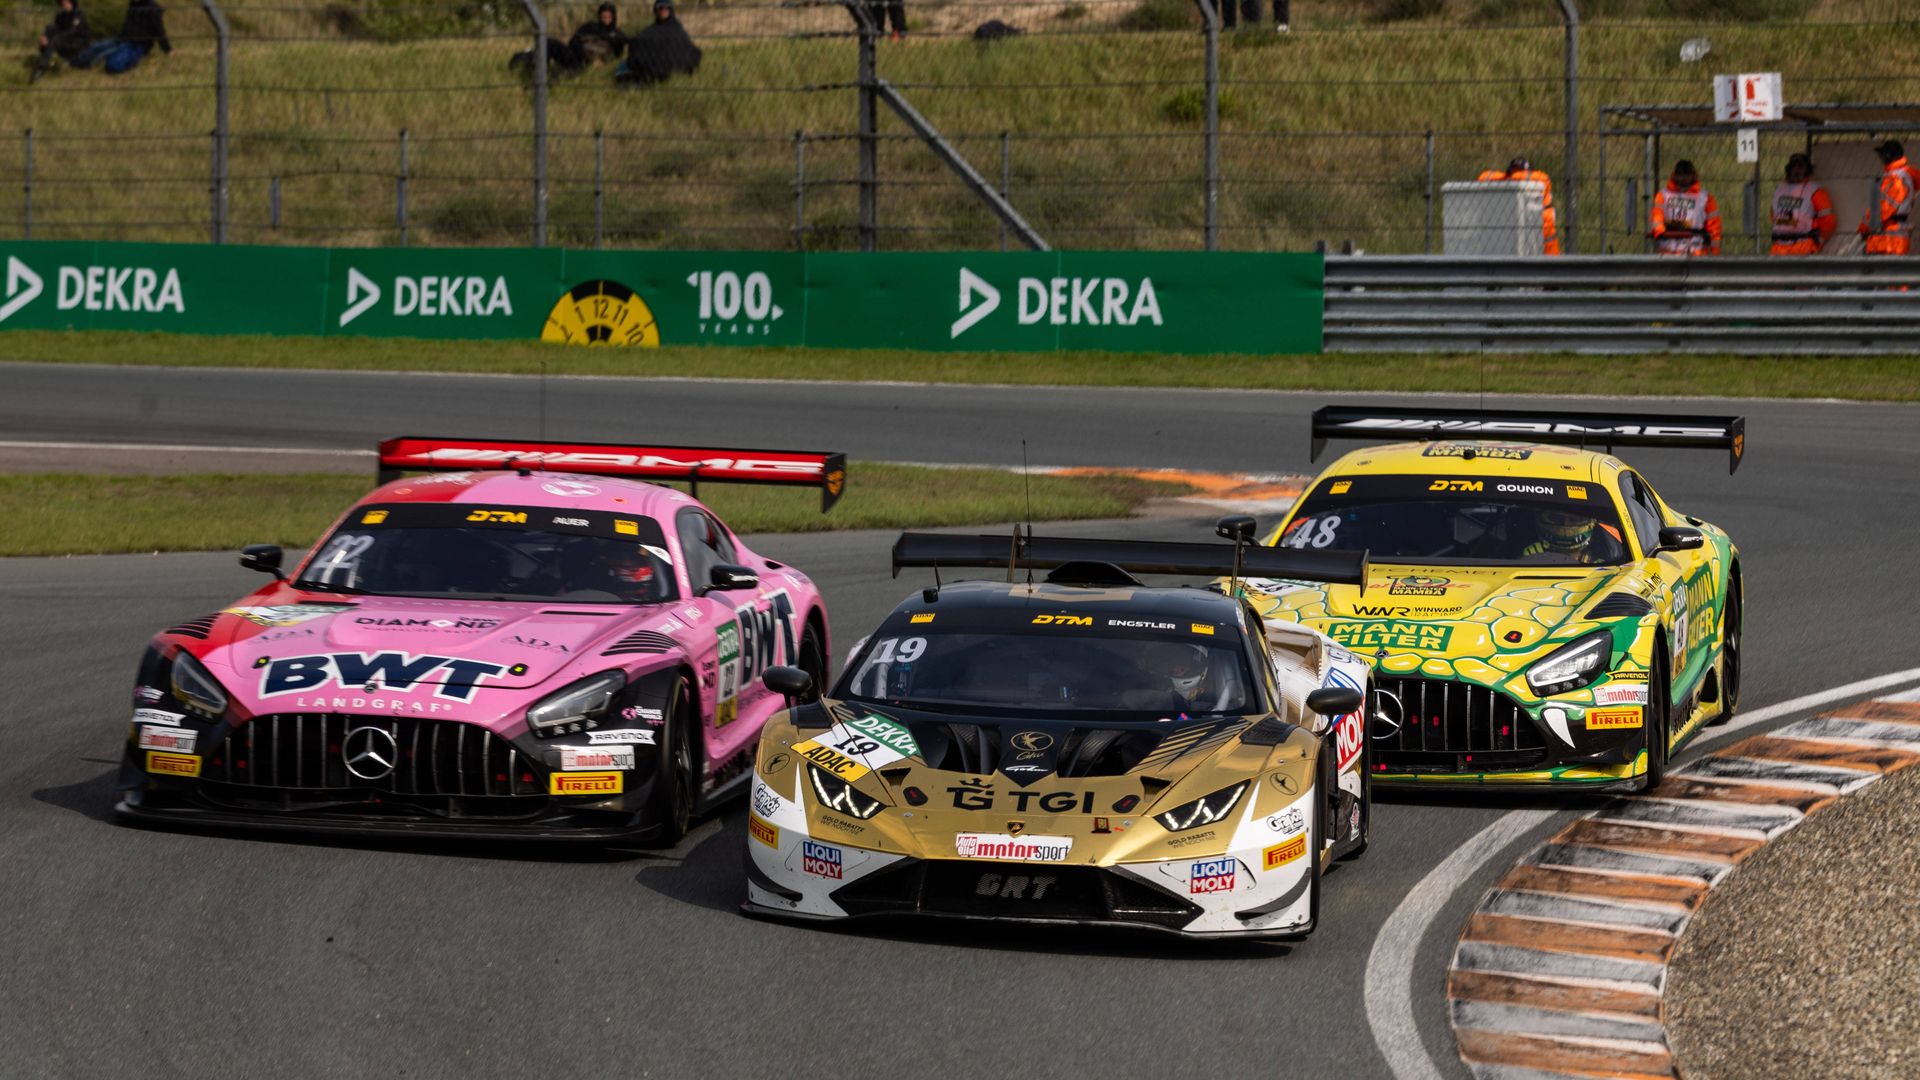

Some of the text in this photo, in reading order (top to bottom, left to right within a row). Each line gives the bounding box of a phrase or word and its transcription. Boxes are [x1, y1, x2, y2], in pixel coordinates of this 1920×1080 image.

[1741, 139, 1755, 152] 11
[57, 266, 185, 313] DEKRA
[394, 276, 513, 316] DEKRA
[593, 298, 609, 319] 12
[1018, 276, 1163, 326] DEKRA
[612, 303, 629, 327] 11
[625, 323, 645, 345] 10
[699, 323, 771, 335] YEARS
[1470, 421, 1728, 437] AMG
[545, 450, 825, 474] AMG
[1428, 479, 1555, 496] DTM GOUNON
[465, 510, 590, 528] DTM AUER
[1289, 515, 1342, 549] 48
[1391, 588, 1443, 596] MAMBA
[1031, 614, 1176, 630] DTM ENGSTLER
[1334, 623, 1447, 638] MANN
[872, 637, 928, 664] 19
[1332, 633, 1443, 650] FILTER
[258, 650, 510, 704] BWT
[1591, 711, 1639, 725] PIRELLI
[595, 733, 650, 741] RAVENOL
[833, 734, 880, 756] 19
[852, 716, 917, 755] DEKRA
[803, 746, 856, 774] ADAC
[557, 775, 616, 791] PIRELLI
[1008, 791, 1095, 814] TGI
[822, 815, 865, 832] GOLD RABATTE
[958, 837, 977, 849] Auto
[1168, 837, 1186, 846] GOLD
[804, 844, 841, 864] LIQUI
[977, 842, 1070, 861] motorsport
[1267, 838, 1306, 866] PIRELLI
[804, 860, 842, 879] MOLY
[1192, 860, 1235, 878] LIQUI
[1192, 876, 1235, 893] MOLY
